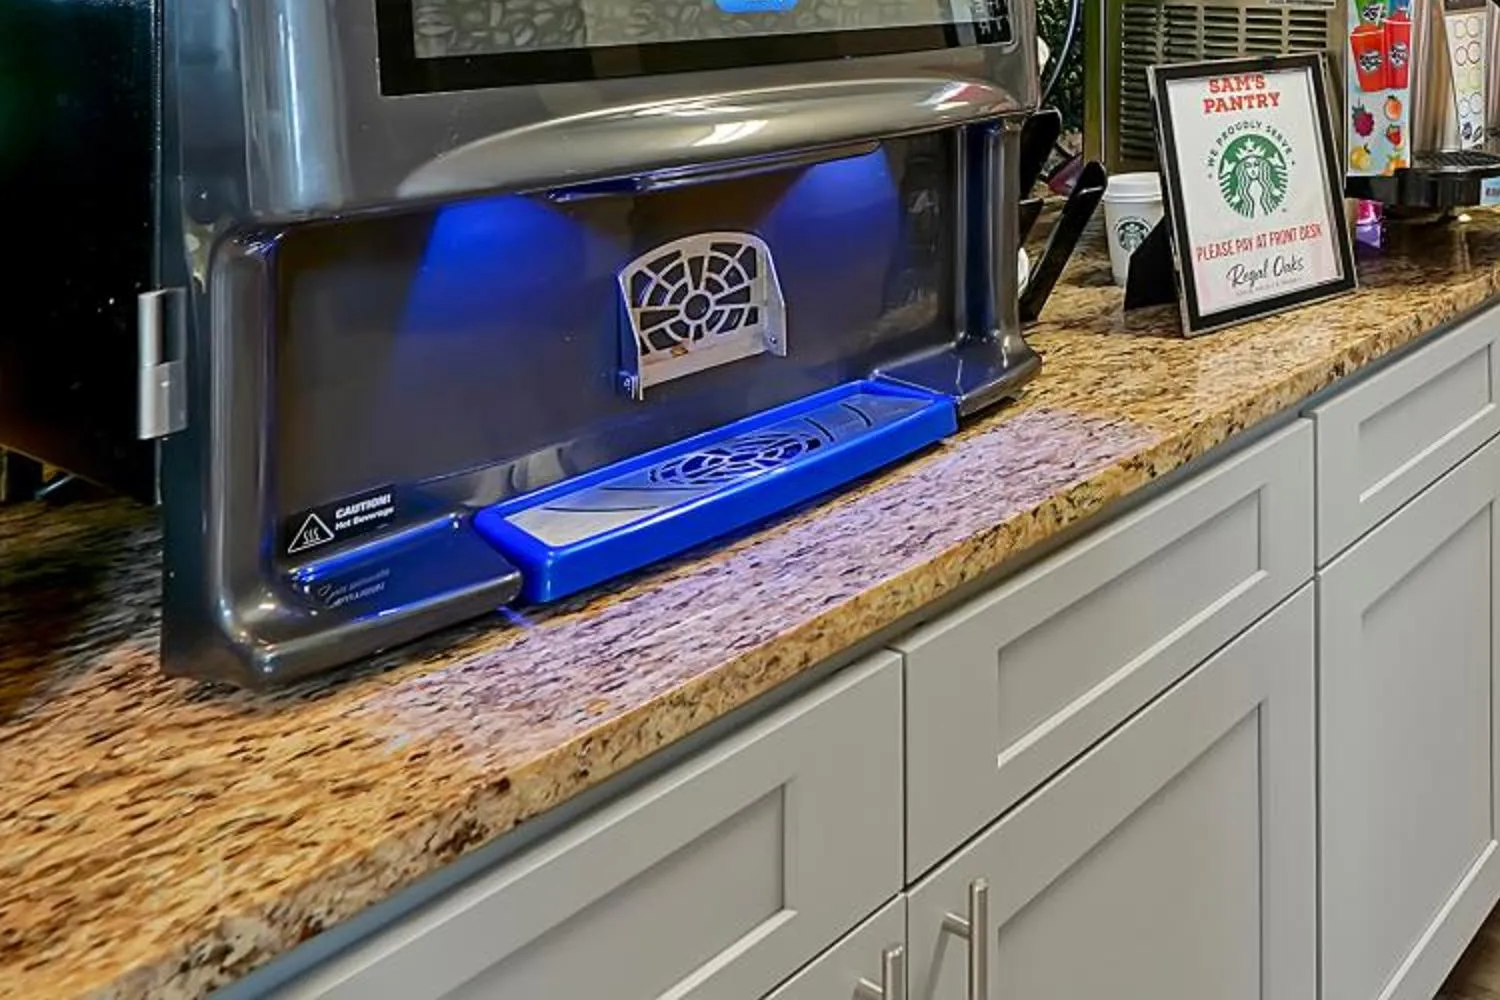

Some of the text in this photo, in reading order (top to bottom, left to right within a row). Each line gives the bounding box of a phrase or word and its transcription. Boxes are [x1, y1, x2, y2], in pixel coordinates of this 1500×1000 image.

[1209, 73, 1266, 94] SAM'S
[1203, 91, 1281, 115] PANTRY
[1207, 120, 1293, 167] WE PROUDLY SERVE
[1196, 238, 1235, 262] PLEASE
[1256, 232, 1267, 249] AT
[1269, 227, 1297, 247] FRONT
[1299, 223, 1322, 241] DESK
[1226, 257, 1269, 288] Regal
[1273, 252, 1305, 277] Oaks
[335, 493, 392, 519] CAUTION!
[335, 519, 352, 531] Hot
